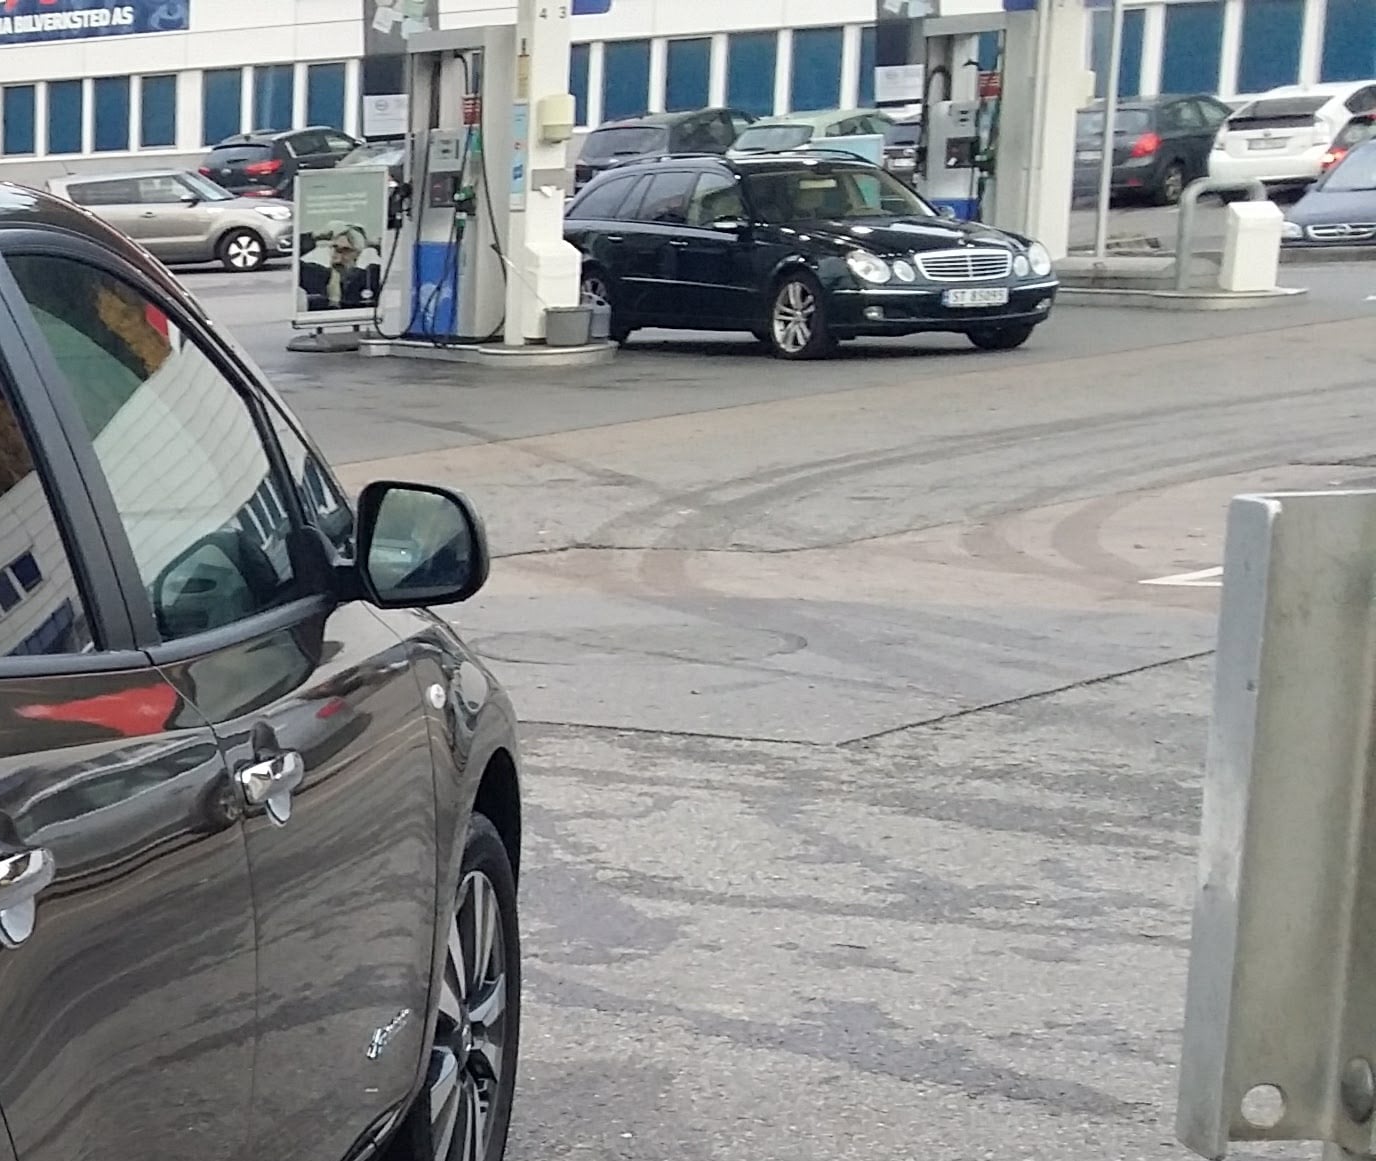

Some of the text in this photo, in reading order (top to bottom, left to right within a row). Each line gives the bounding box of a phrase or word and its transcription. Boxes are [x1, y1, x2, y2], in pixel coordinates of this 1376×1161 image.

[14, 8, 111, 34] BILVERKSTED
[111, 6, 134, 26] AS
[539, 6, 567, 20] 4 3
